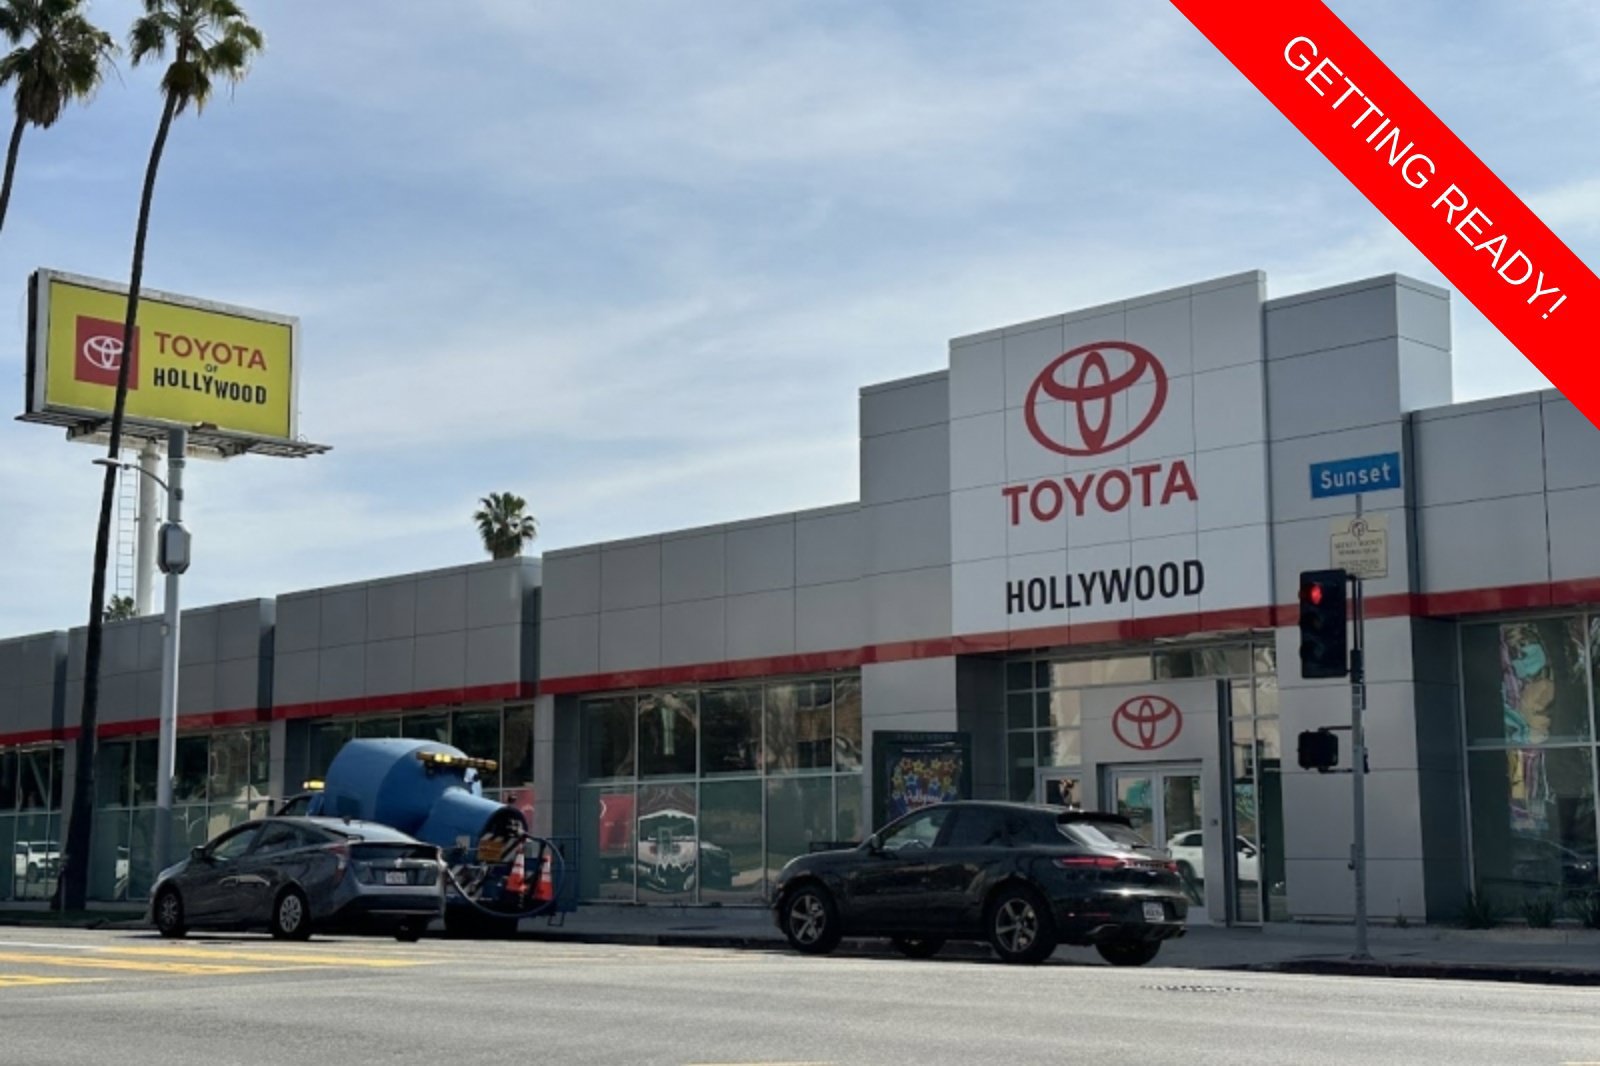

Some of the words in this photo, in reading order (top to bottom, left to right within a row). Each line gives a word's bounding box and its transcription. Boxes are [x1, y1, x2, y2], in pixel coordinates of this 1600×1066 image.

[154, 332, 267, 370] TOYOTA
[204, 363, 218, 374] OF
[153, 367, 267, 405] HOLLYWOOD
[1002, 460, 1199, 526] TOYOTA
[1320, 462, 1391, 489] Sunset
[1006, 559, 1205, 615] HOLLYWOOD
